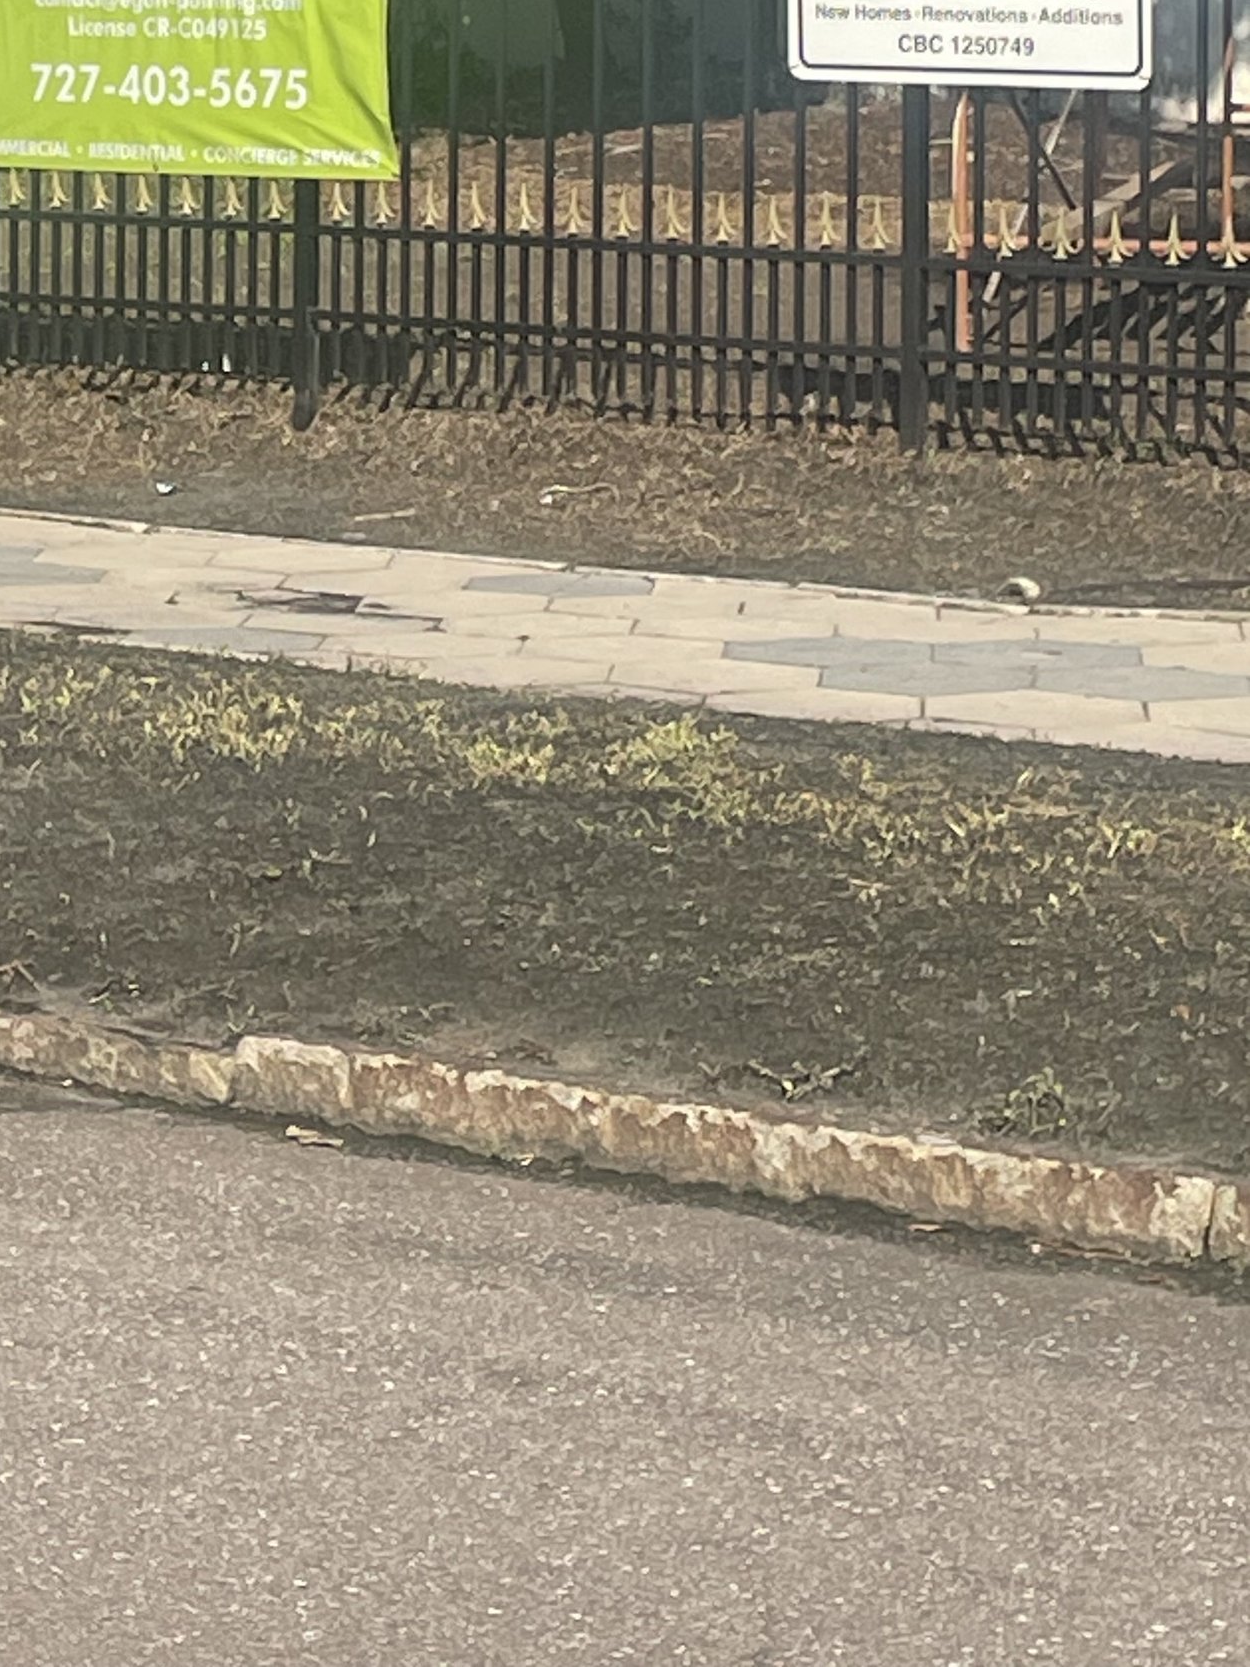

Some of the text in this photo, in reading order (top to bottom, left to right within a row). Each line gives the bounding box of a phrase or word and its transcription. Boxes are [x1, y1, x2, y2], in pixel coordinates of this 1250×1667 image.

[67, 15, 137, 37] License
[815, 4, 1124, 26] New Homes Renovations Additions
[898, 34, 1035, 56] CBC 1250749
[30, 63, 308, 111] 727-403-5675
[89, 142, 186, 162] RESIDENTIAL
[203, 146, 299, 166] CONCIERGE
[303, 149, 381, 168] SERVICES
